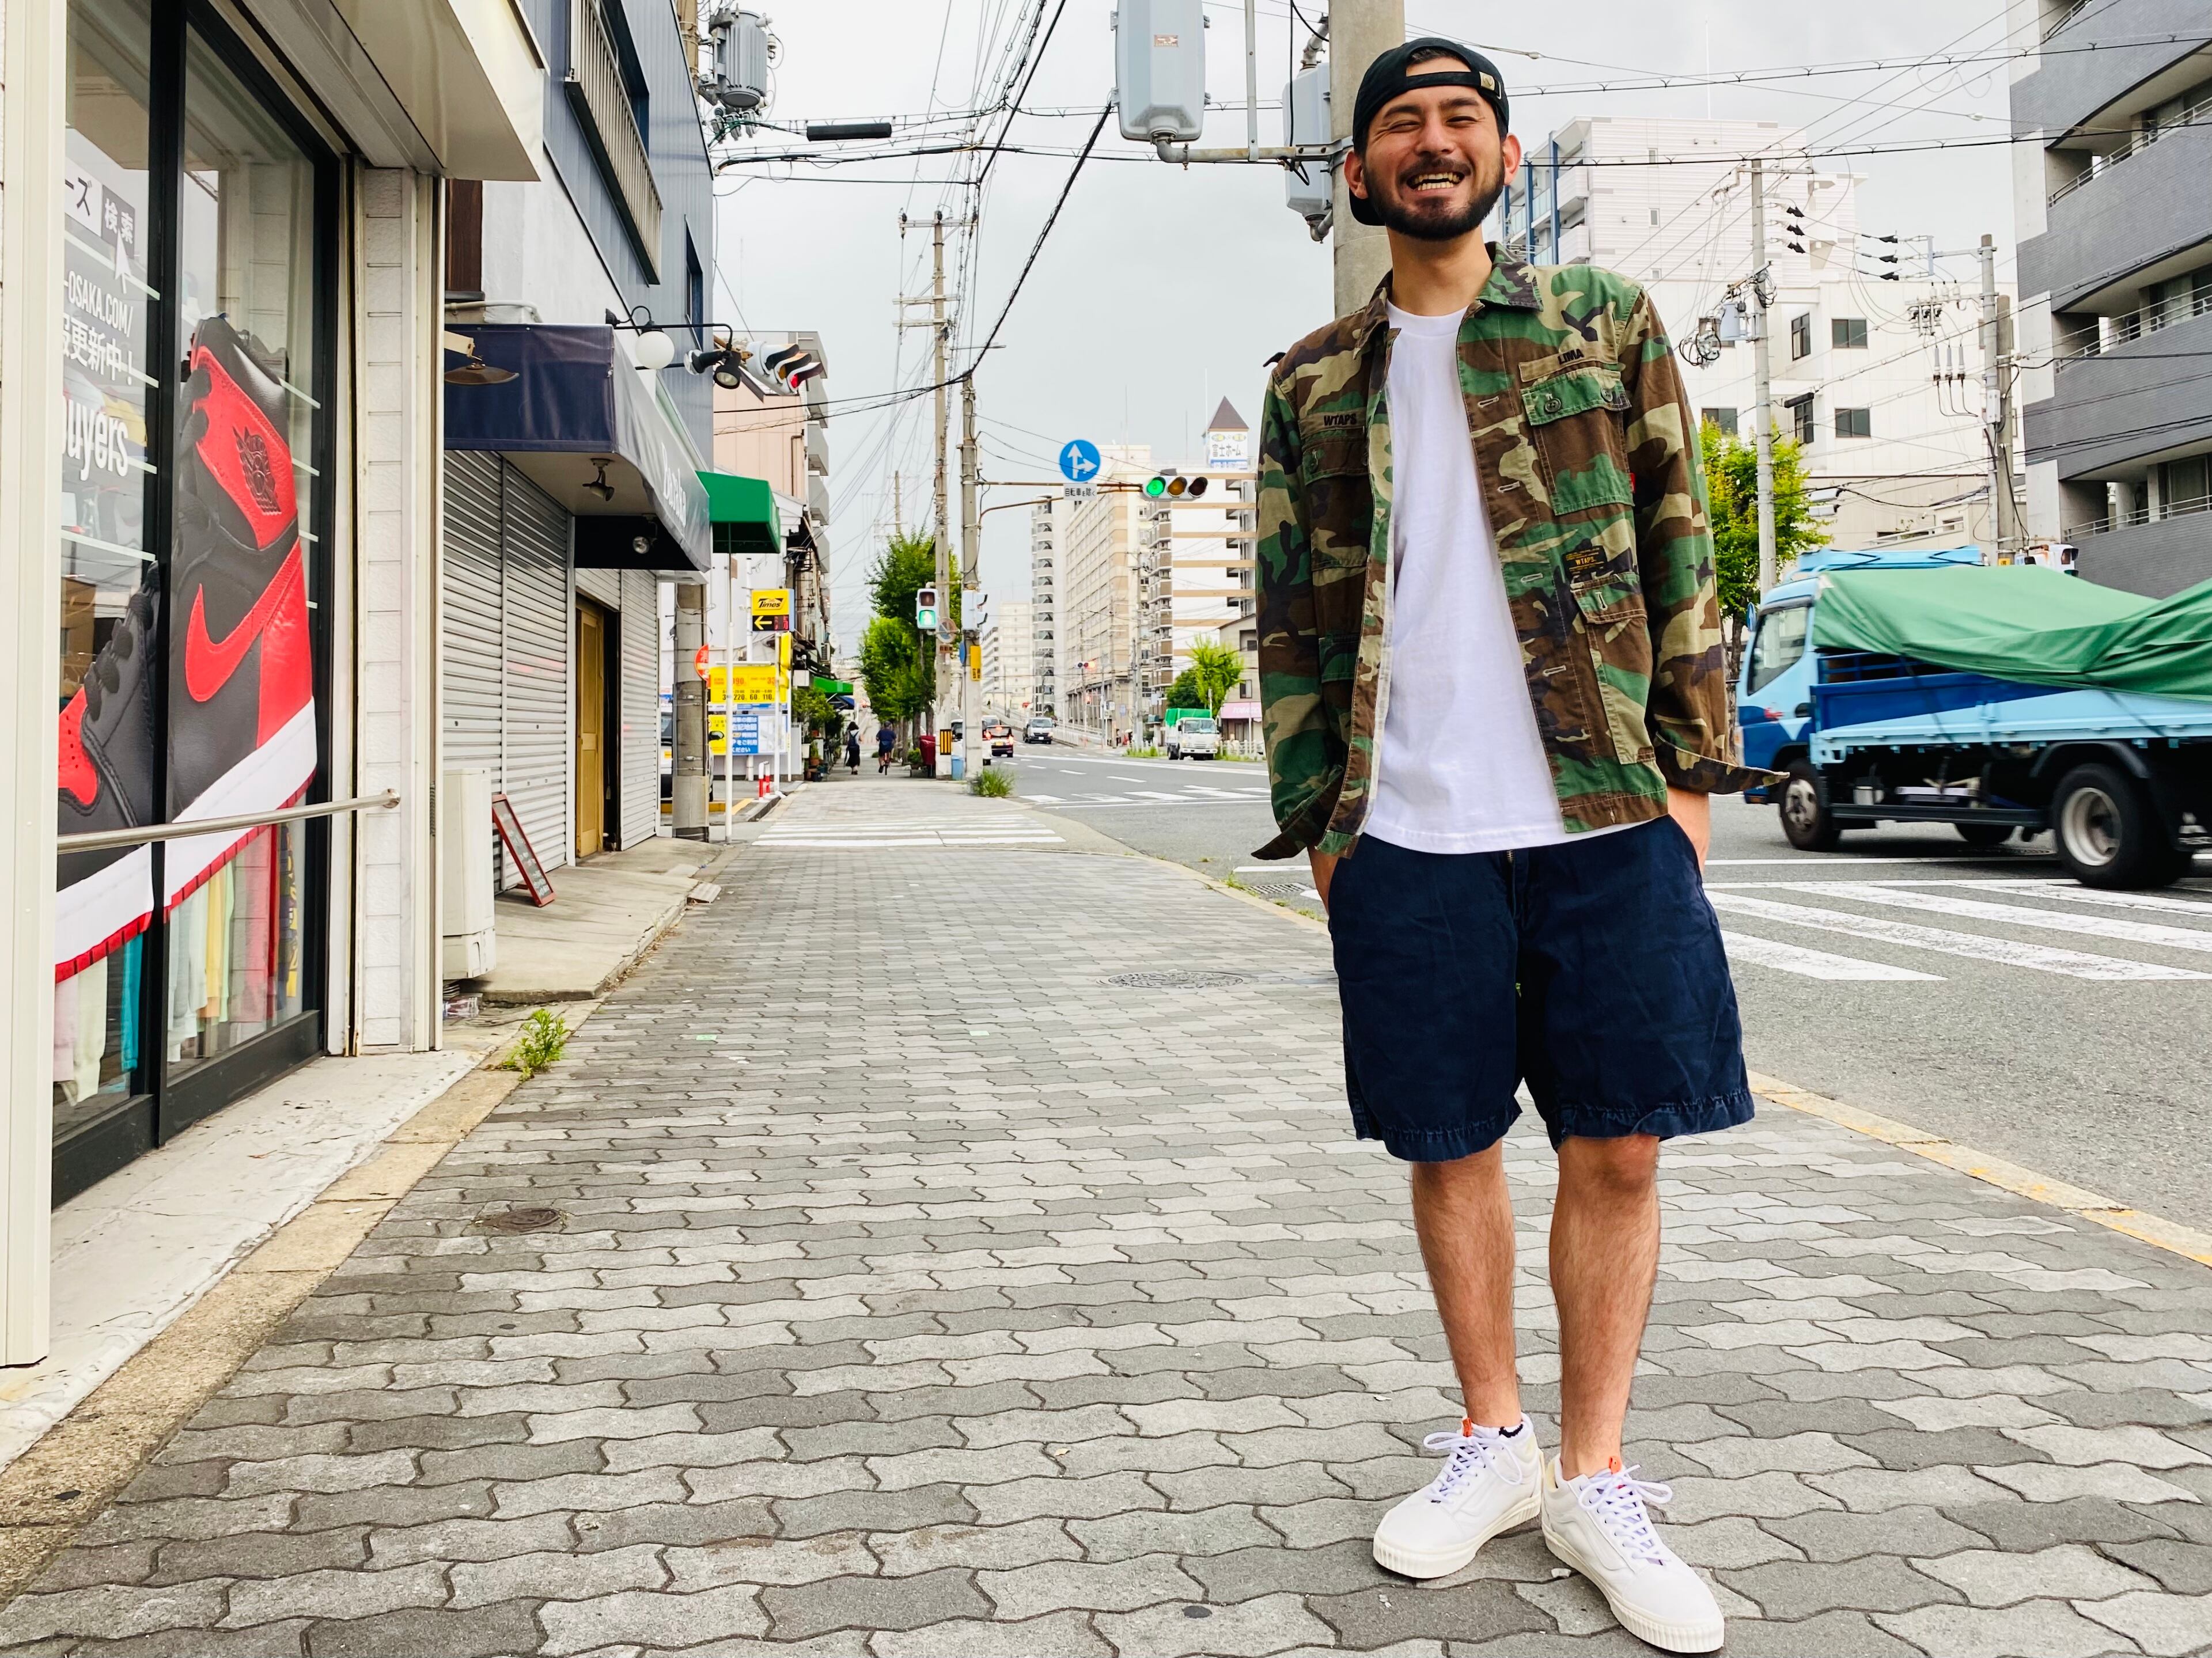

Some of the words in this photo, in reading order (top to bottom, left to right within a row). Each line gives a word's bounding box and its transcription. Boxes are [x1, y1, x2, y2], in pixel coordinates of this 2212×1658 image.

[104, 198, 134, 244] 検索
[1557, 348, 1585, 365] LIMA
[1323, 413, 1357, 426] WTAPS
[1575, 556, 1594, 566] WTAPS
[757, 598, 782, 608] Times
